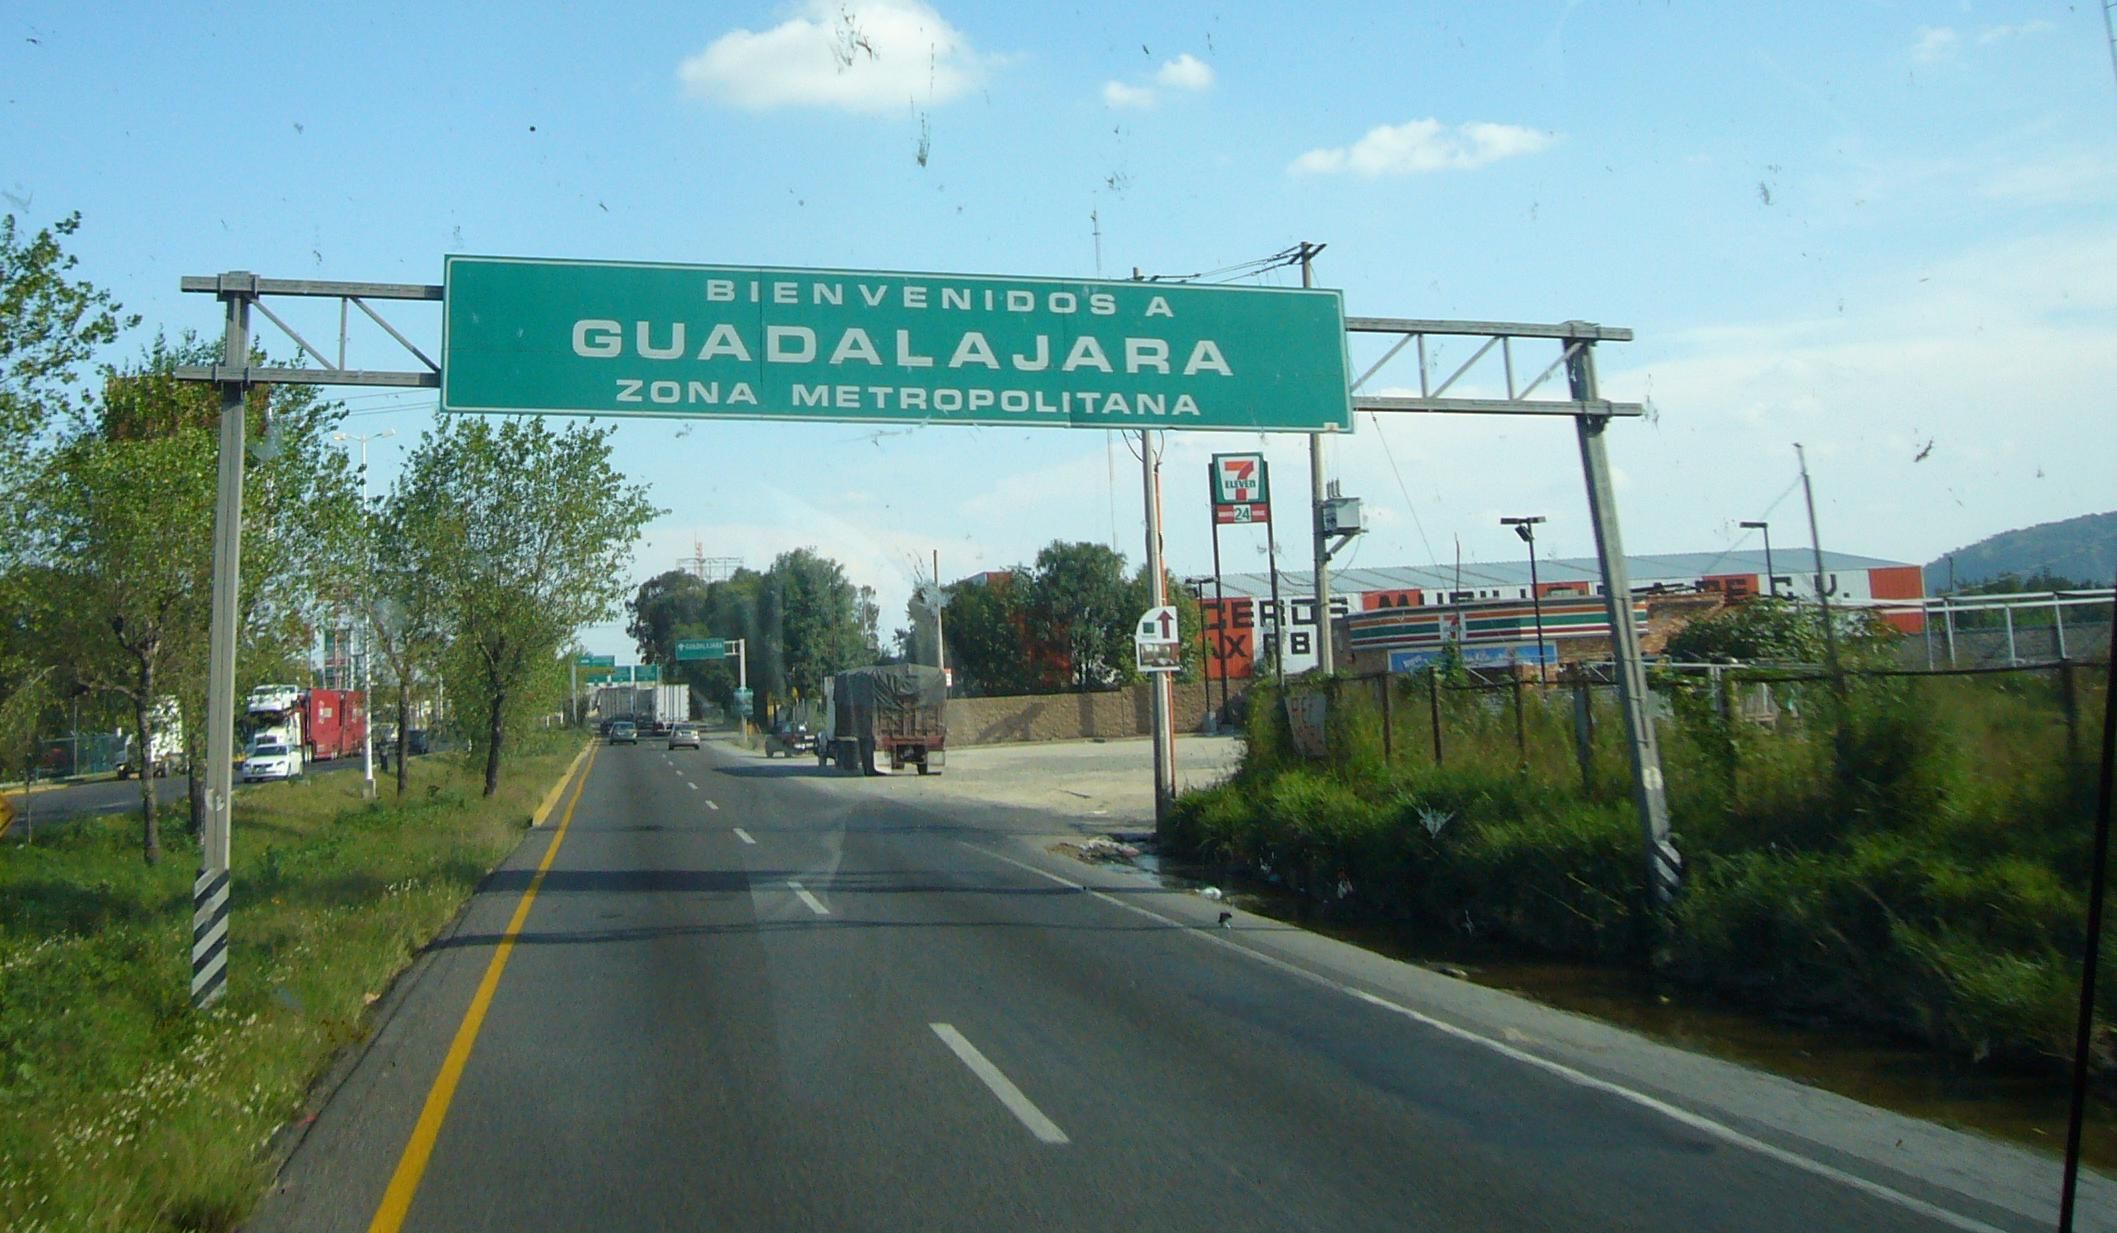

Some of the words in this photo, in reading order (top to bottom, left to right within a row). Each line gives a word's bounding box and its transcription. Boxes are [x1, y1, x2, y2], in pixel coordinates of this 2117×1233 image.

[707, 279, 1116, 315] BIENVENIDOS
[1145, 296, 1174, 318] A
[572, 318, 1233, 377] GUADALAJARA
[616, 379, 758, 406] ZONA
[791, 384, 1201, 417] METROPOLITANA
[1224, 460, 1254, 501] 7
[1235, 507, 1251, 521] 24
